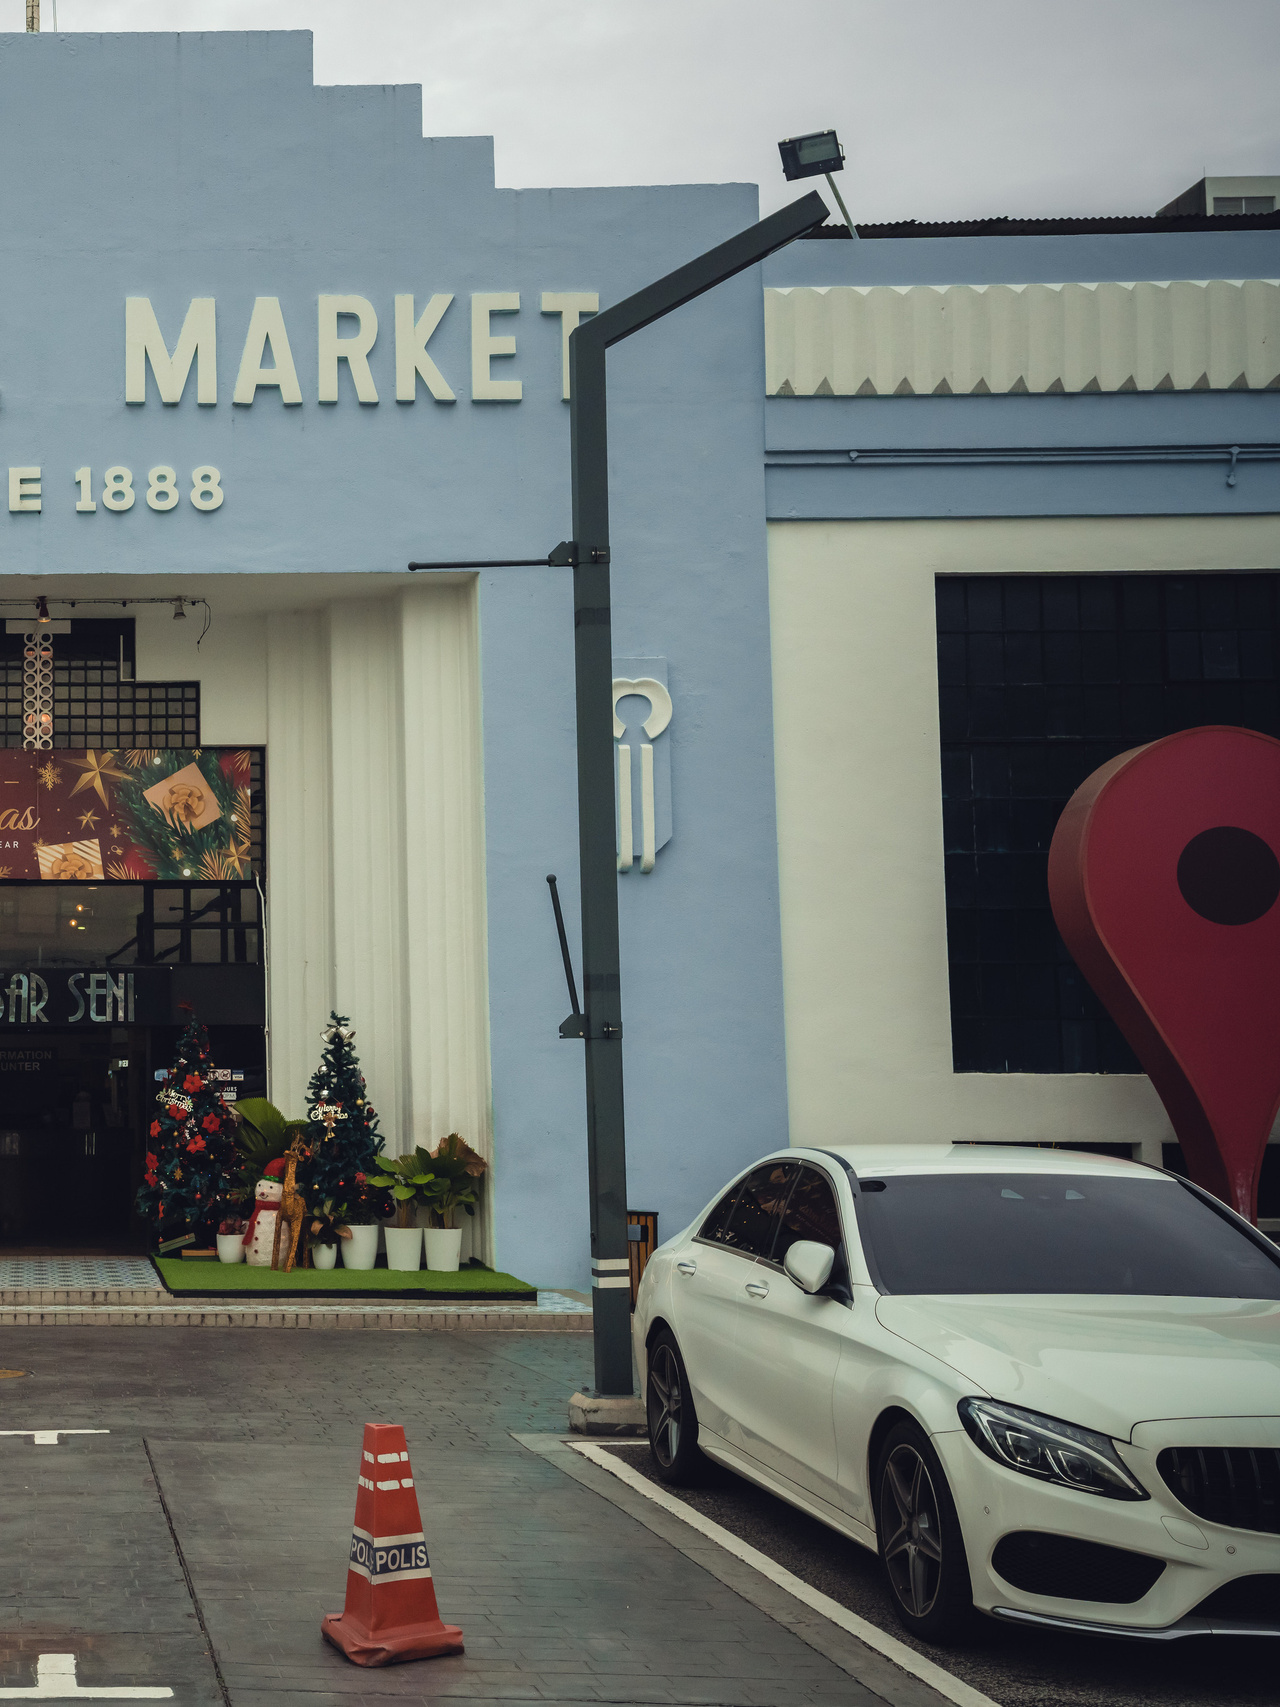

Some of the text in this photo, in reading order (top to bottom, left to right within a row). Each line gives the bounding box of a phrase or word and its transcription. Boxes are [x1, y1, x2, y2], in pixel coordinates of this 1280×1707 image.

[125, 292, 600, 407] MARKET
[75, 466, 225, 512] 1888
[67, 971, 135, 1022] SENI
[375, 1545, 428, 1572] POLIS
